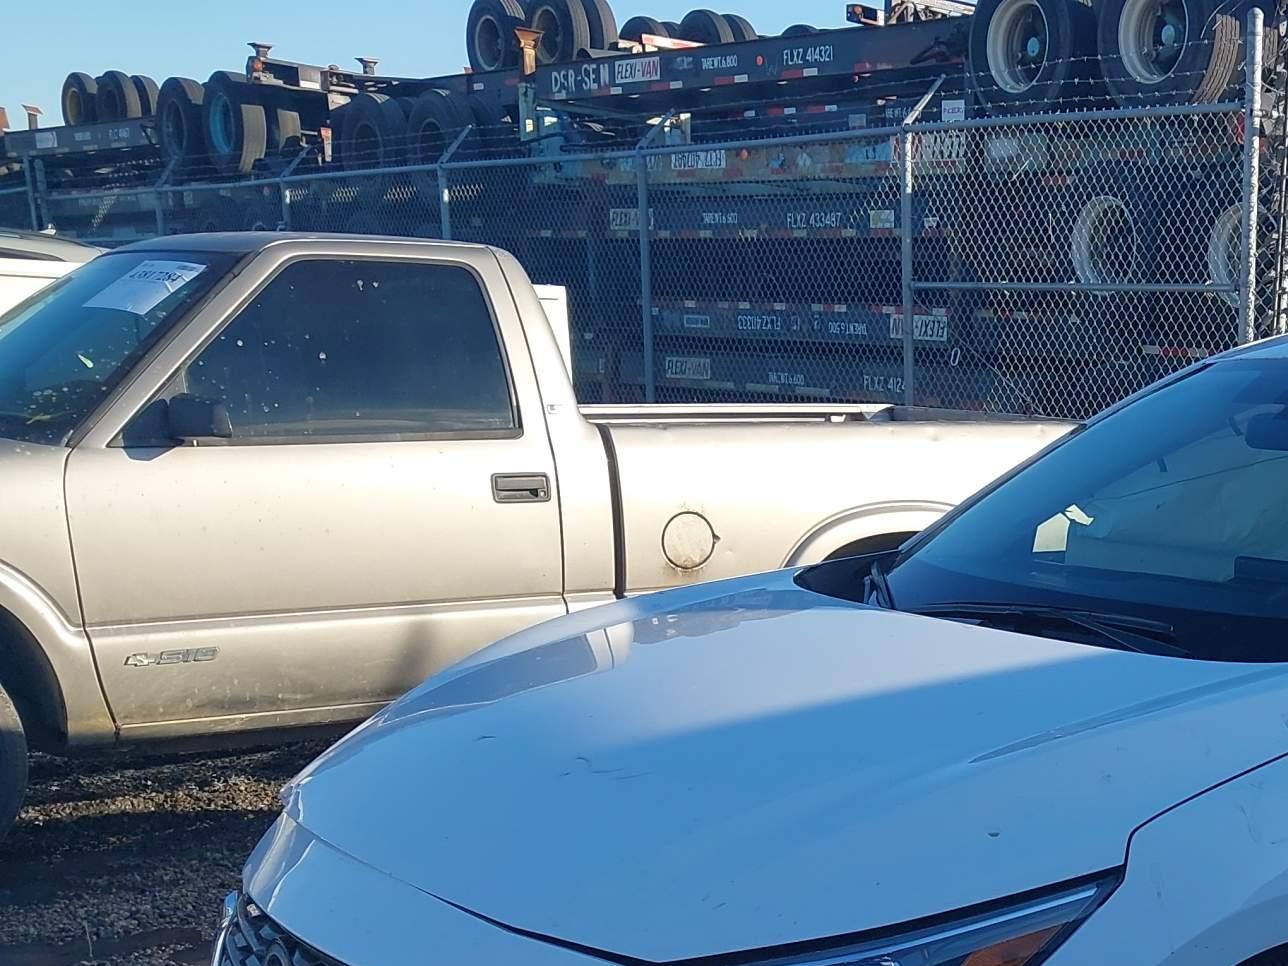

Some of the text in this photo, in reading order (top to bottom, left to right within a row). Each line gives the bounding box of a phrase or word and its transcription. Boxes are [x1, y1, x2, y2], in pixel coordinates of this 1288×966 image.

[783, 46, 833, 66] FLXZ 414321
[616, 58, 659, 81] FLEXI-VAN
